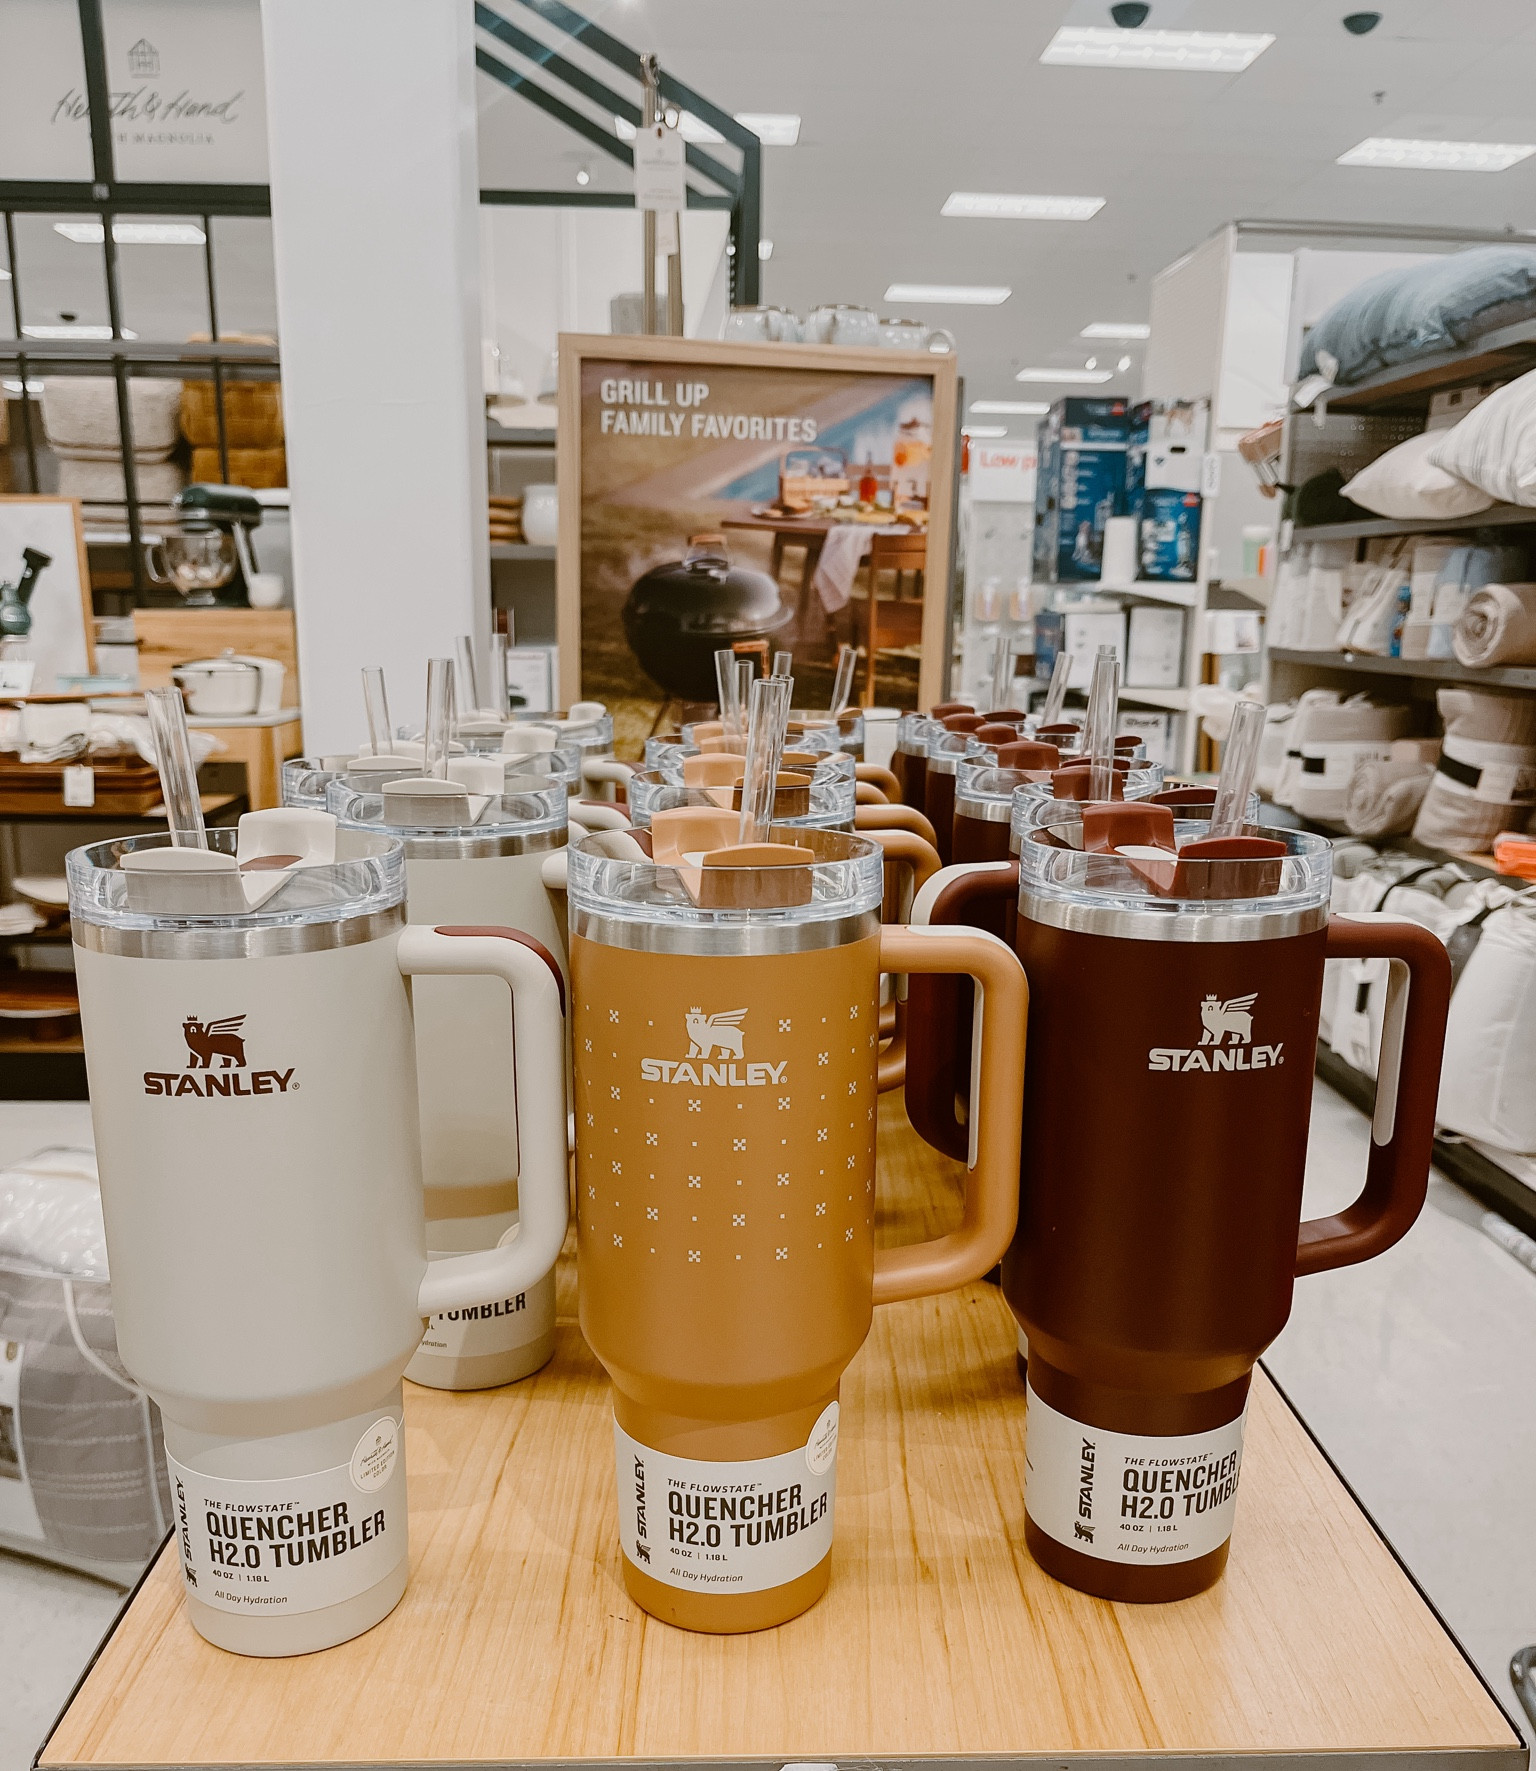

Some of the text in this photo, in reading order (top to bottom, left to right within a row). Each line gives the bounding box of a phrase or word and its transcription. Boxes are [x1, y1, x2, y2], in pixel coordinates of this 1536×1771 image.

[51, 87, 147, 124] Heth
[600, 379, 709, 407] GRILL UP
[600, 409, 817, 442] FAMILY FAVORITES
[980, 451, 1017, 468] Low
[1124, 1456, 1146, 1467] THE
[1122, 1450, 1238, 1494] QUENCHER
[667, 1478, 687, 1490] THE
[203, 1498, 222, 1510] THE
[668, 1483, 803, 1521] QUENCHER
[1120, 1494, 1175, 1520] H2.0
[206, 1501, 350, 1541] QUENCHER
[668, 1491, 828, 1548] H2.0 TUMBLER
[1119, 1523, 1131, 1531] 40
[1132, 1524, 1145, 1532] OZ
[208, 1509, 386, 1569] H2.0 TUMBLER
[669, 1547, 680, 1555] 40
[681, 1549, 693, 1558] OZ
[705, 1553, 721, 1561] 1.18
[1117, 1543, 1190, 1555] All Day Hydration
[212, 1569, 222, 1577] 40
[223, 1571, 234, 1580] OZ
[669, 1567, 743, 1583] All Day Hydration
[214, 1590, 288, 1605] All Day Hydration
